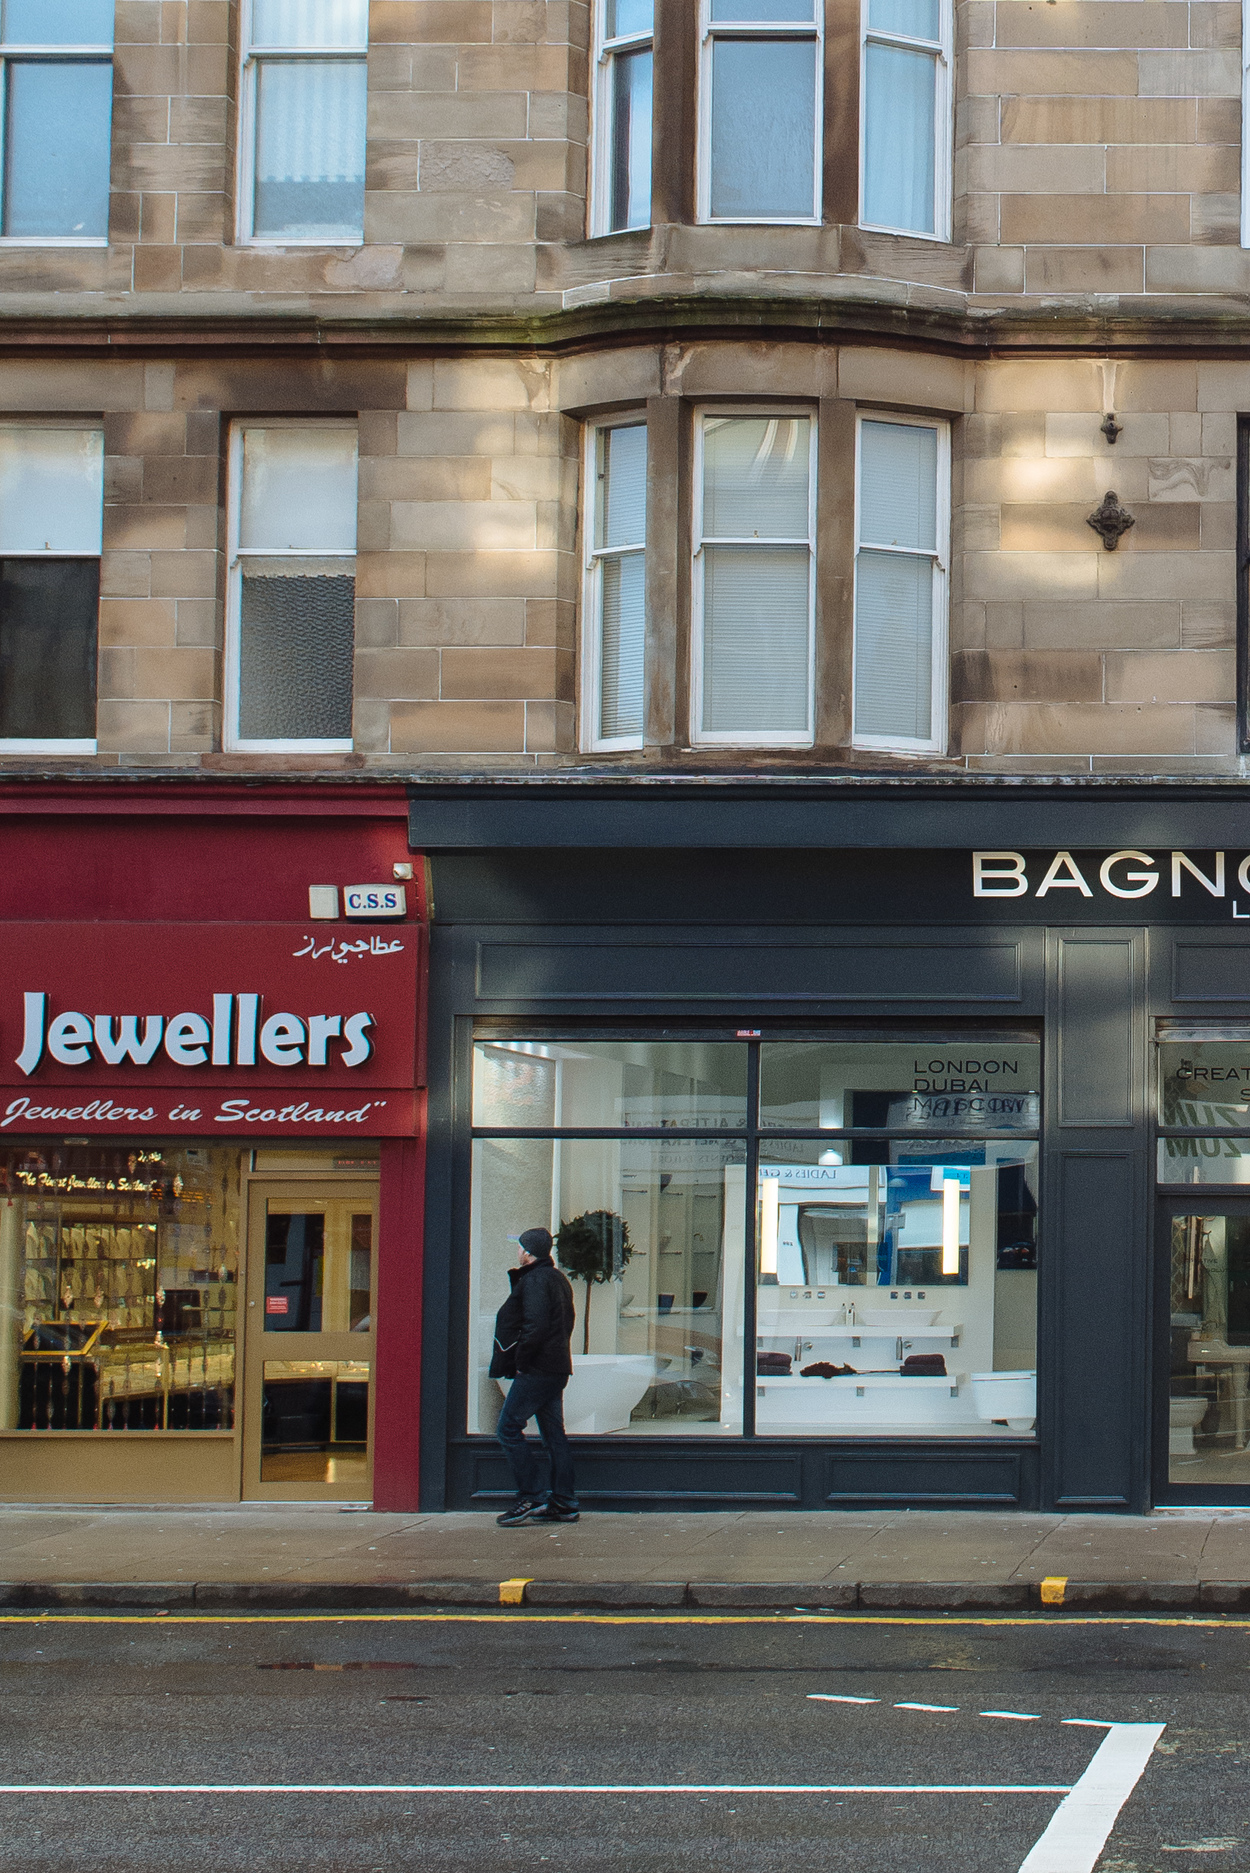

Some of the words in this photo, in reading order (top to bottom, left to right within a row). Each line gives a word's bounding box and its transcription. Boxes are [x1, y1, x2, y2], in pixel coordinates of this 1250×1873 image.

[348, 893, 397, 909] C.S.S
[15, 991, 373, 1076] Jewellers
[913, 1060, 1019, 1074] LONDON
[914, 1079, 988, 1093] DUBAI
[0, 1097, 158, 1128] Jewellers
[168, 1103, 202, 1121] in
